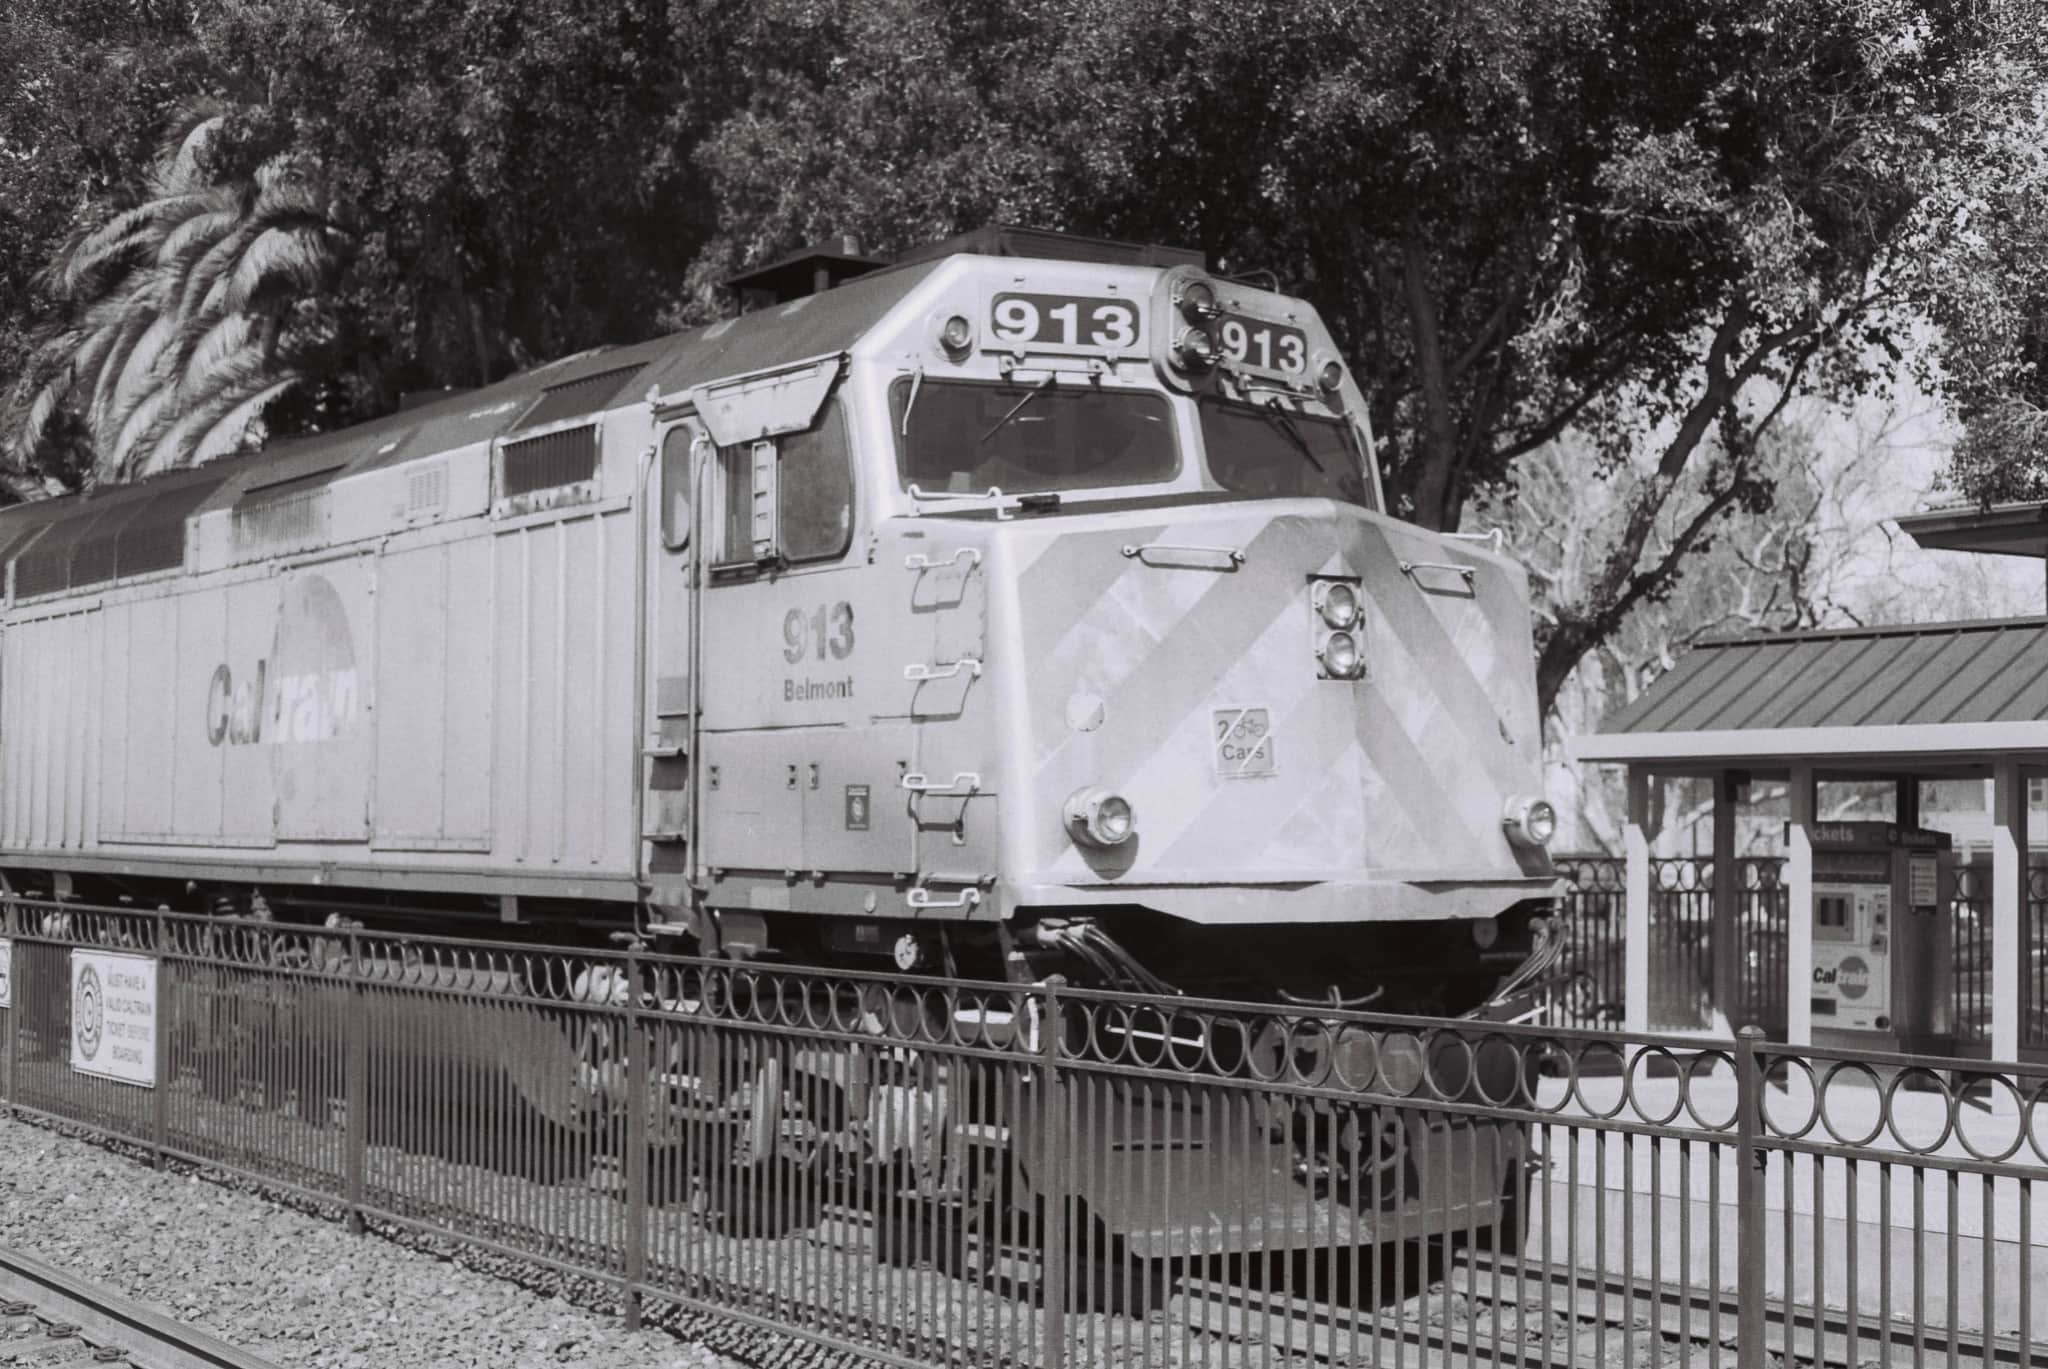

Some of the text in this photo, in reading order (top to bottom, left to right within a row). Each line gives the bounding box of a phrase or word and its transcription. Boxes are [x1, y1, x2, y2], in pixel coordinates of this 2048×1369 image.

[994, 299, 1135, 348] 913
[1221, 321, 1306, 376] 913
[783, 601, 855, 664] 913
[784, 675, 854, 702] Belmont
[1222, 743, 1265, 761] Cars
